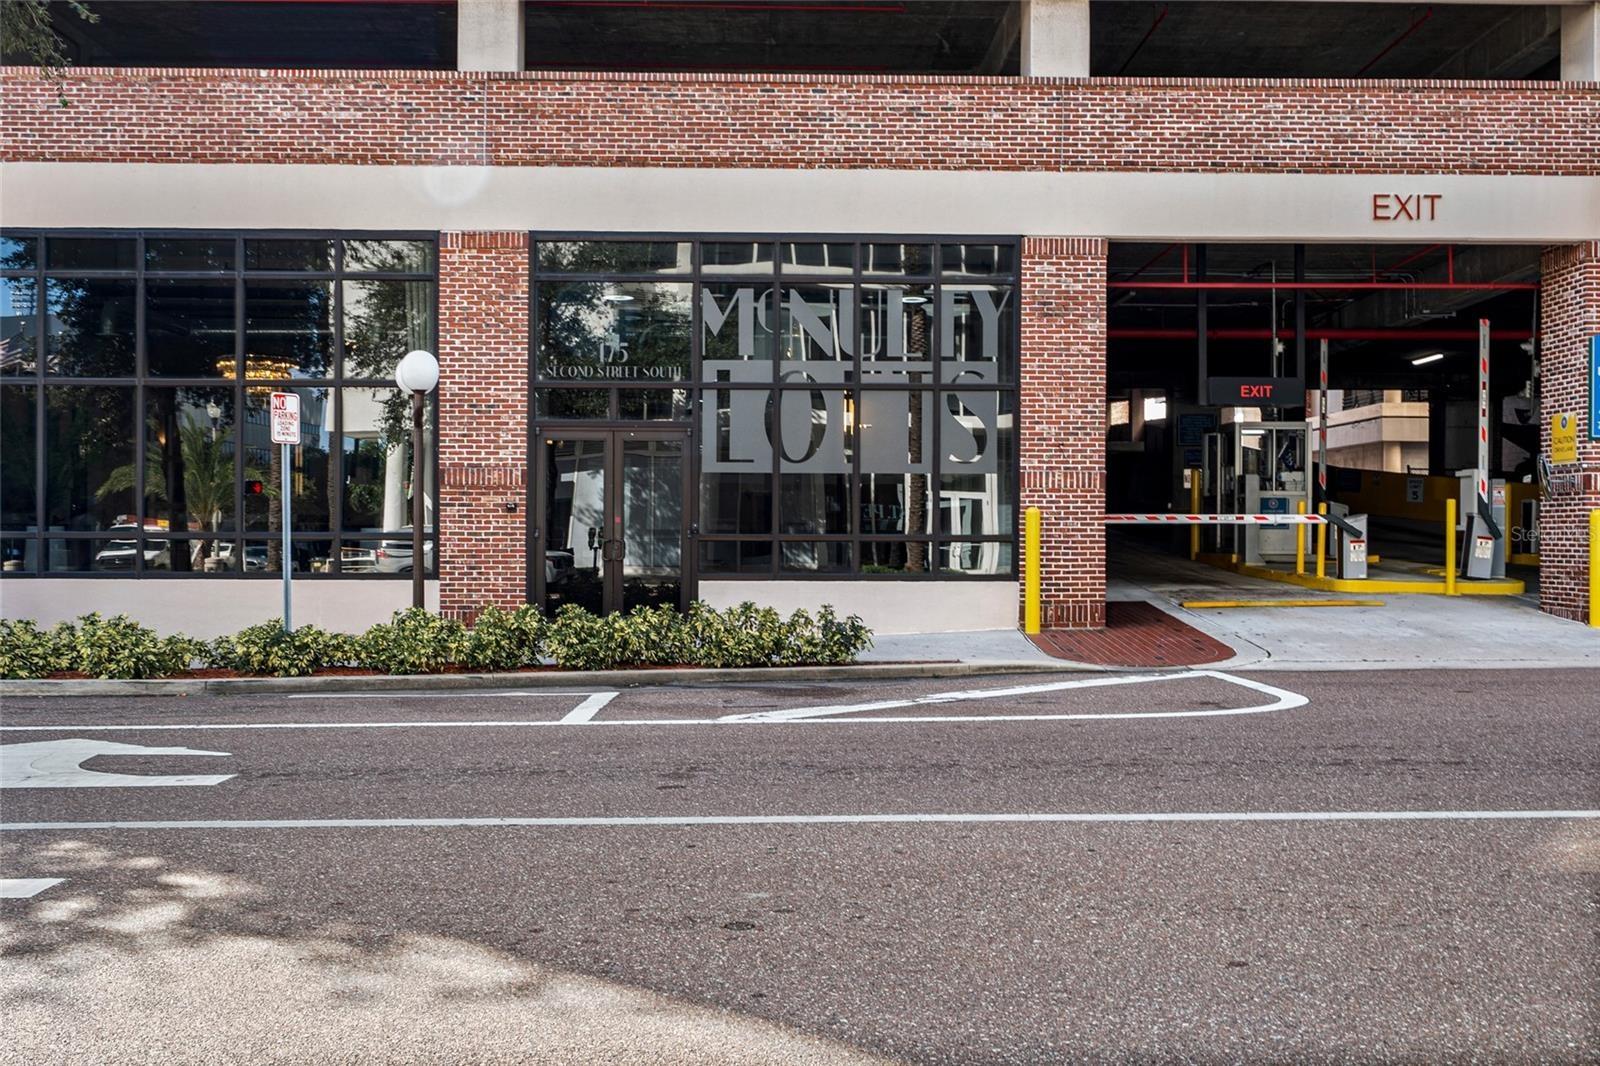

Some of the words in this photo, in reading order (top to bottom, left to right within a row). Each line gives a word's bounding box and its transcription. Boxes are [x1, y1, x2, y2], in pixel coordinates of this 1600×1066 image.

[1373, 194, 1442, 220] EXIT
[600, 342, 629, 363] 175
[546, 366, 594, 379] SECOND
[597, 366, 638, 379] STREET
[642, 366, 682, 379] SOUTH
[1240, 385, 1273, 398] EXIT
[272, 396, 287, 410] NO
[273, 410, 298, 421] PARKING
[716, 369, 988, 464] LOFTS
